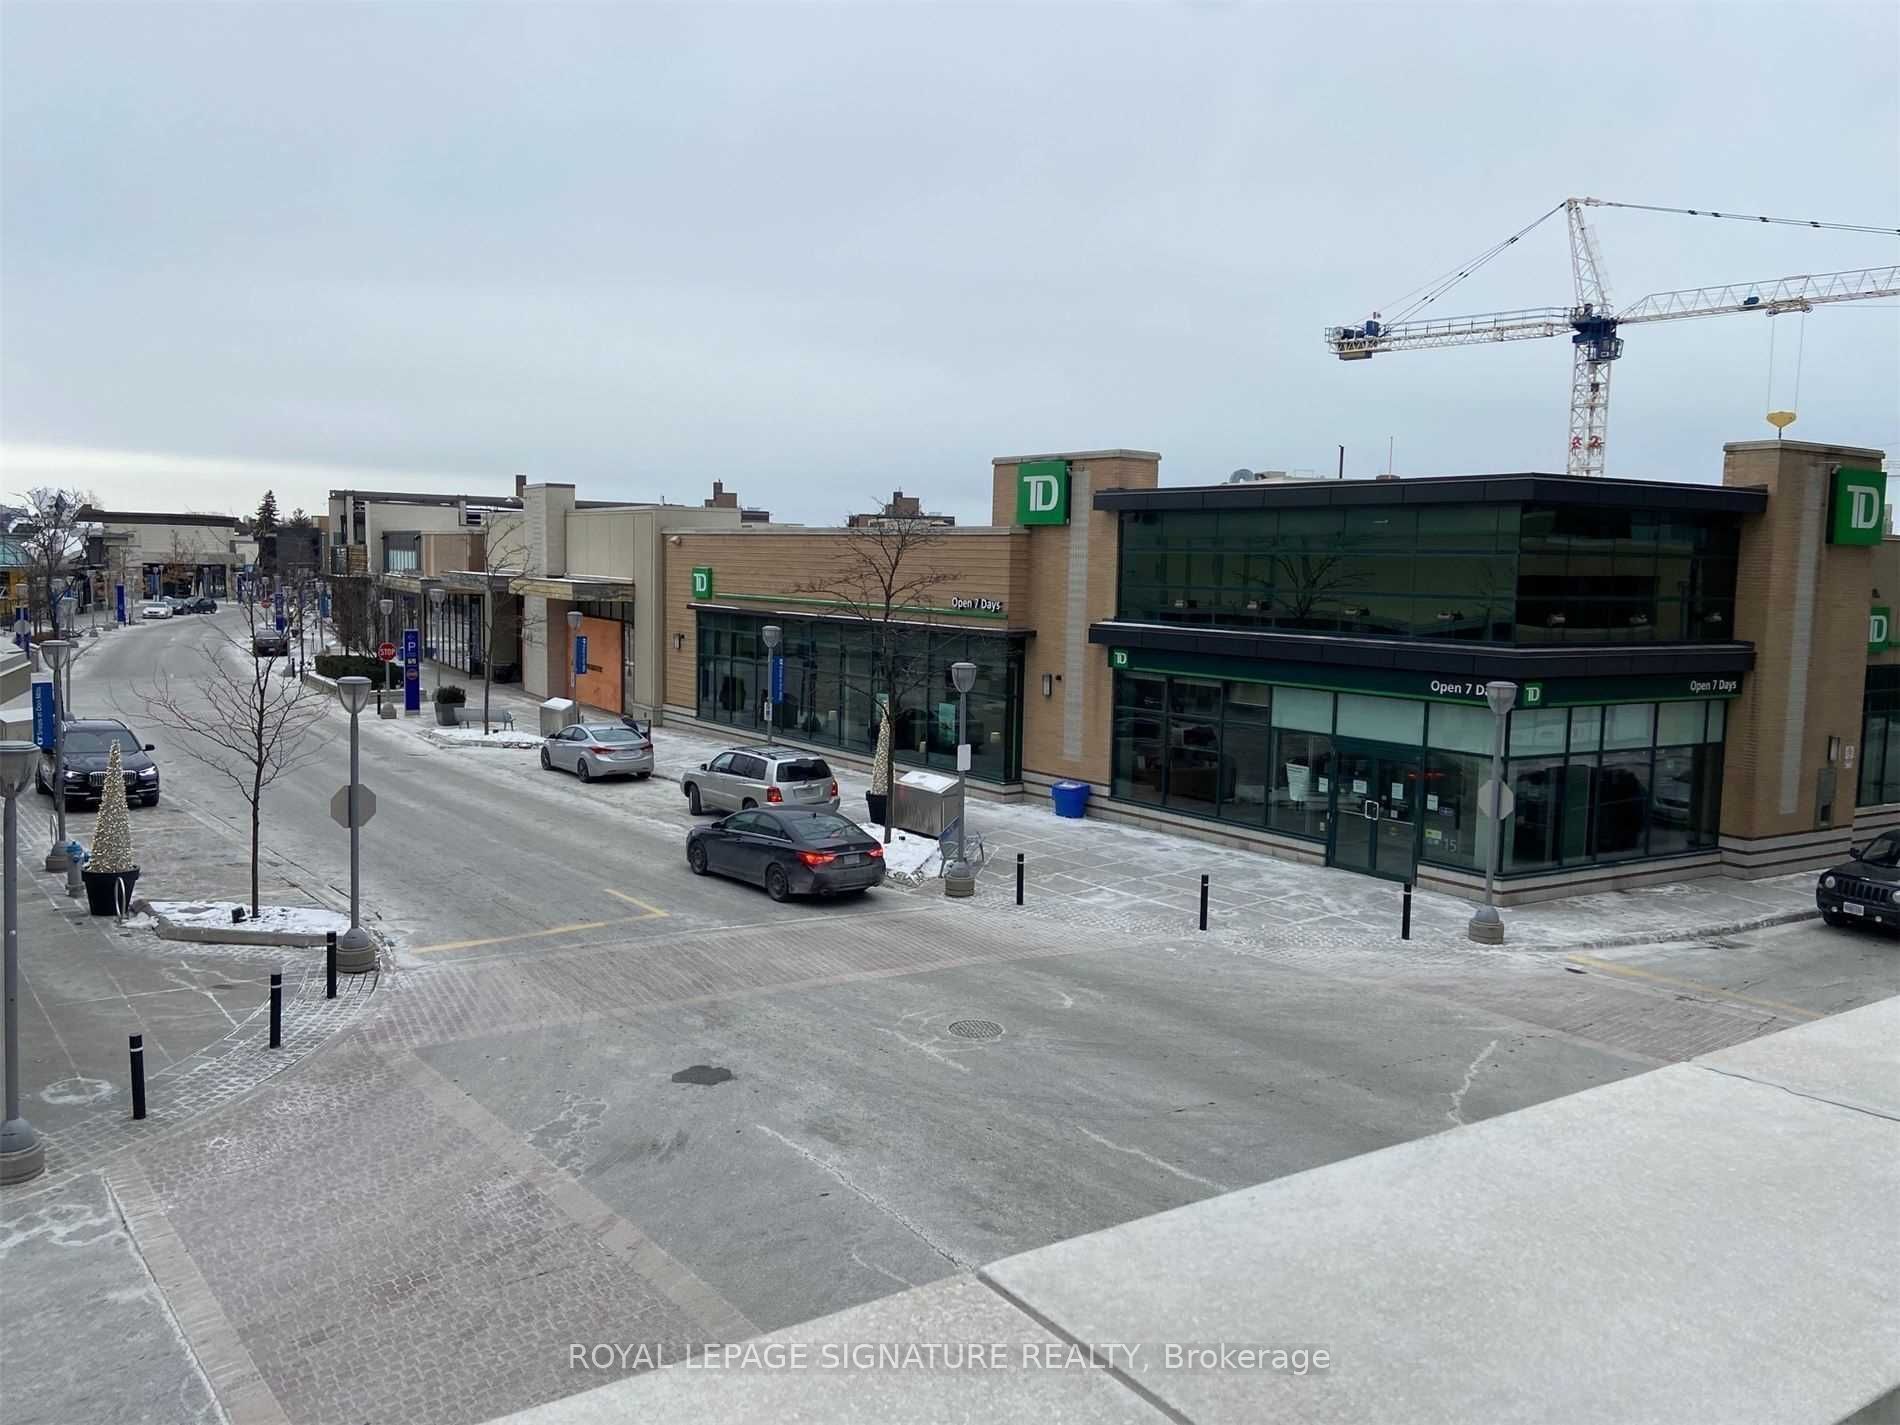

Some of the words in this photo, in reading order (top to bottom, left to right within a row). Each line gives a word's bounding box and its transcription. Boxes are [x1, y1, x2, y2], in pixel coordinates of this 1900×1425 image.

[1023, 474, 1059, 512] TD
[1847, 484, 1880, 529] TD
[693, 573, 707, 591] TD
[951, 596, 973, 609] Open
[981, 598, 1001, 613] Days
[380, 648, 395, 656] STOP
[408, 642, 416, 651] P
[1115, 651, 1128, 665] TD
[1430, 680, 1462, 695] Open
[1465, 683, 1473, 695] 7
[1690, 680, 1711, 693] Open
[1712, 679, 1718, 691] 7
[1719, 679, 1737, 692] Days
[1526, 687, 1540, 702] TD
